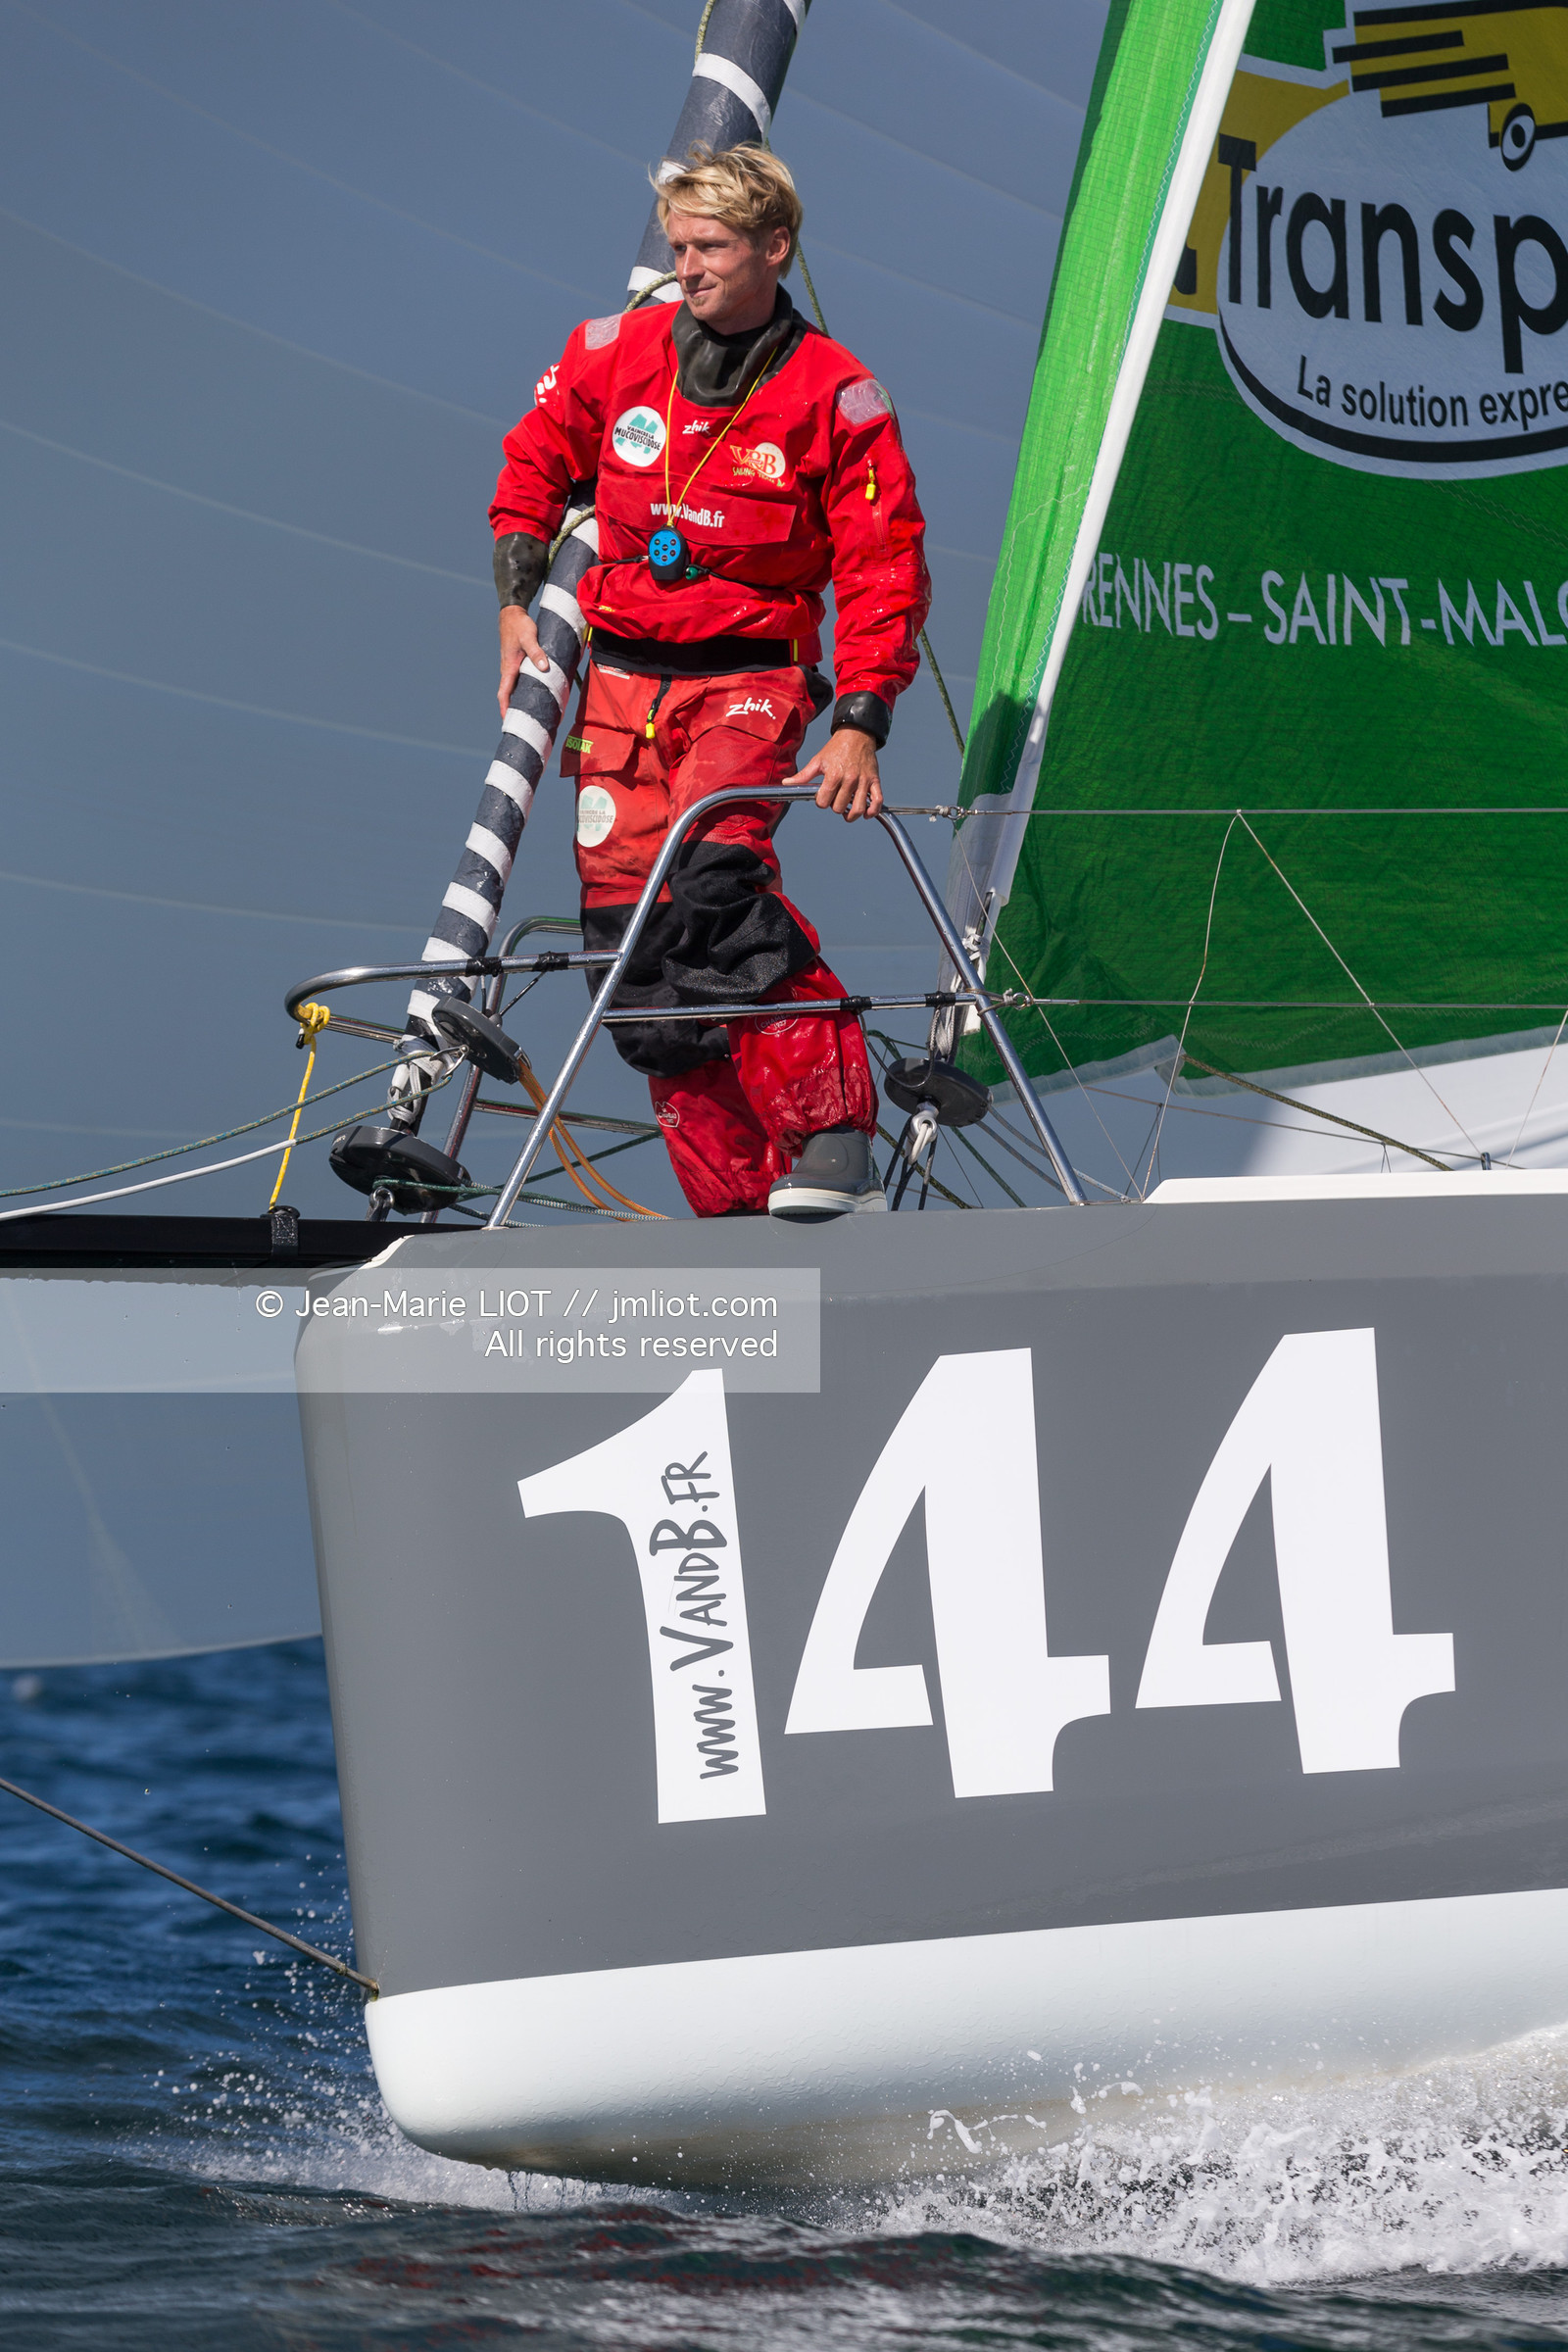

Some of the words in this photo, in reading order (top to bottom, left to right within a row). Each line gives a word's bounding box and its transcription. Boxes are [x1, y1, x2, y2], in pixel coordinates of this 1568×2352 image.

[1218, 133, 1568, 374] Transp
[1297, 354, 1331, 408] La
[1341, 380, 1469, 428] solution
[1479, 380, 1568, 431] expre
[614, 426, 662, 451] MUCOVISCIDOSE
[681, 419, 711, 436] zhik
[725, 697, 774, 717] zhik
[517, 1327, 1456, 1824] 144
